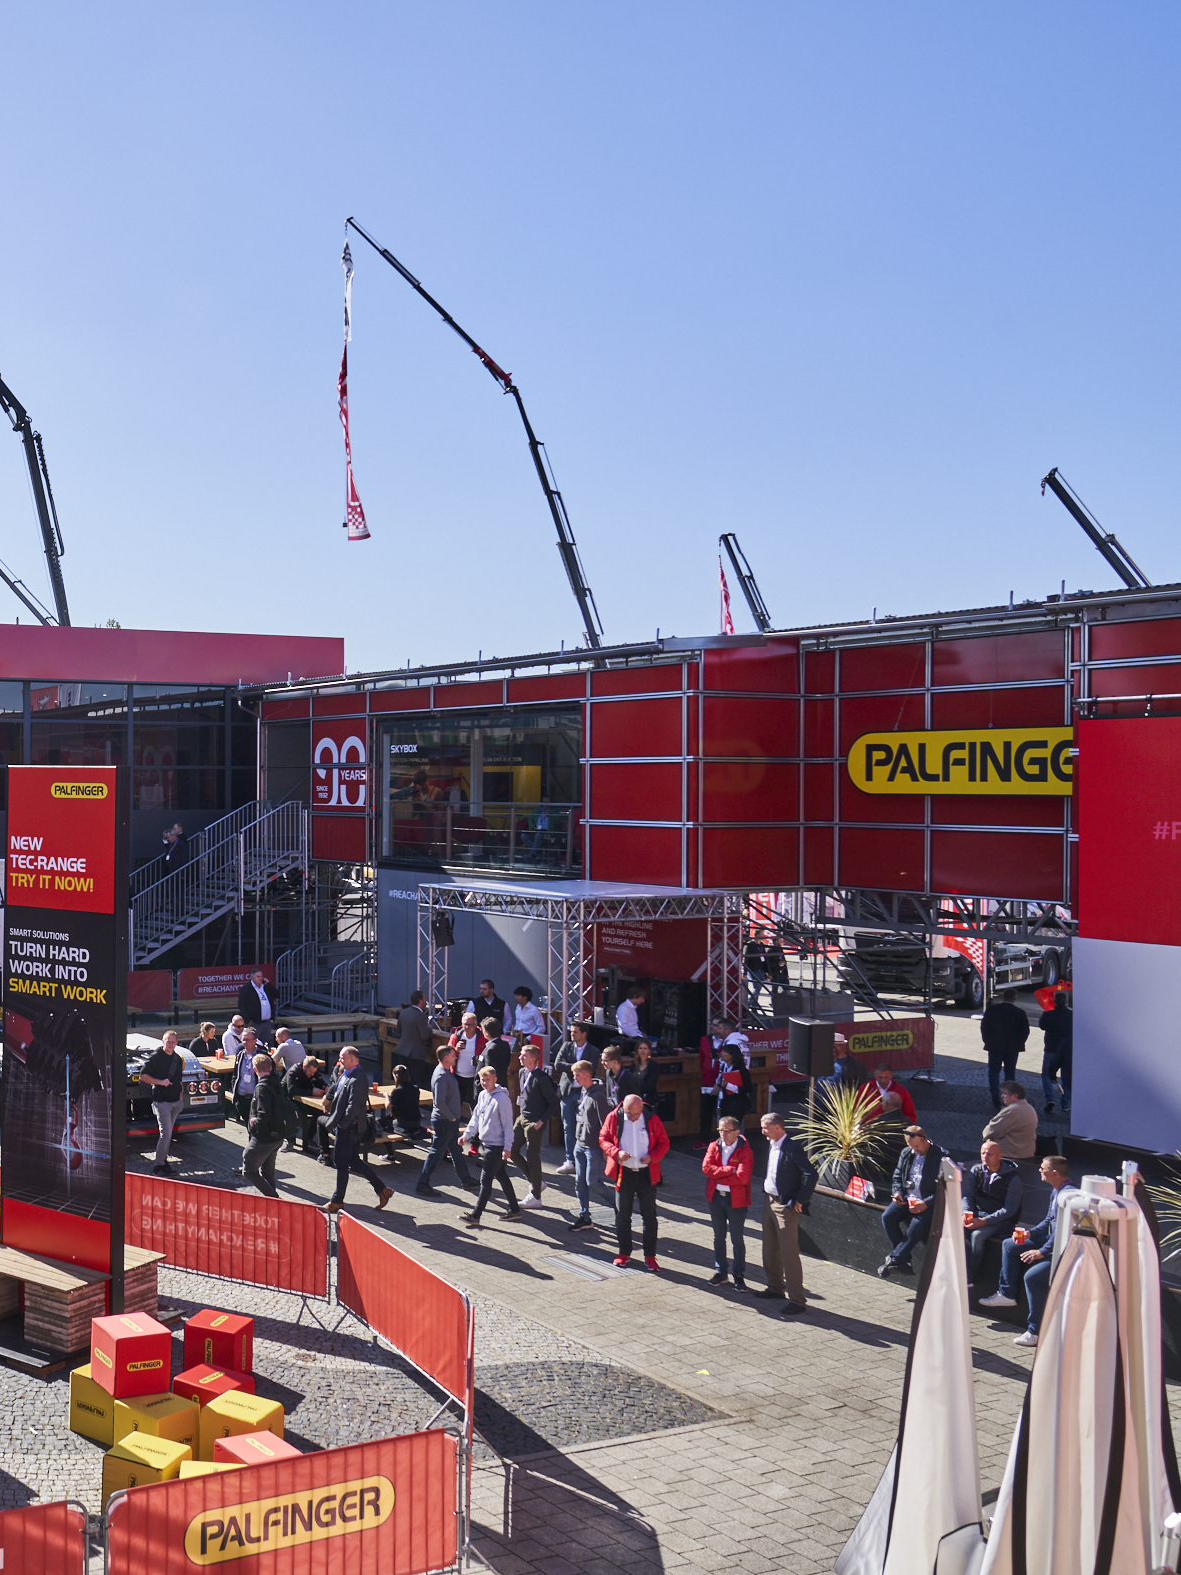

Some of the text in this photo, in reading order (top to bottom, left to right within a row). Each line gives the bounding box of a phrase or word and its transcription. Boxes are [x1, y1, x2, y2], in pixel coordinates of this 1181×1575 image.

[390, 744, 418, 753] SKYBOX
[865, 740, 1073, 783] PALFINGE
[340, 770, 366, 780] YEARS
[54, 785, 104, 796] PALFINGER
[10, 836, 43, 851] NEW
[10, 854, 86, 872] TEC-RANGE
[10, 873, 94, 892] TRY IT NOW!
[9, 927, 69, 941] SMART SOLUTIONS
[617, 928, 647, 938] REFRESH
[602, 936, 653, 949] YOURSELF HERE
[9, 941, 90, 963] TURN HARD
[9, 959, 88, 982] WORK INTO
[198, 974, 232, 982] TOGETHER
[9, 977, 107, 1004] SMART WORK
[852, 1033, 910, 1049] PALFINGER
[128, 1360, 161, 1370] PALFINGER
[76, 1401, 105, 1417] PALFINGER
[200, 1486, 381, 1556] PALFINGER
